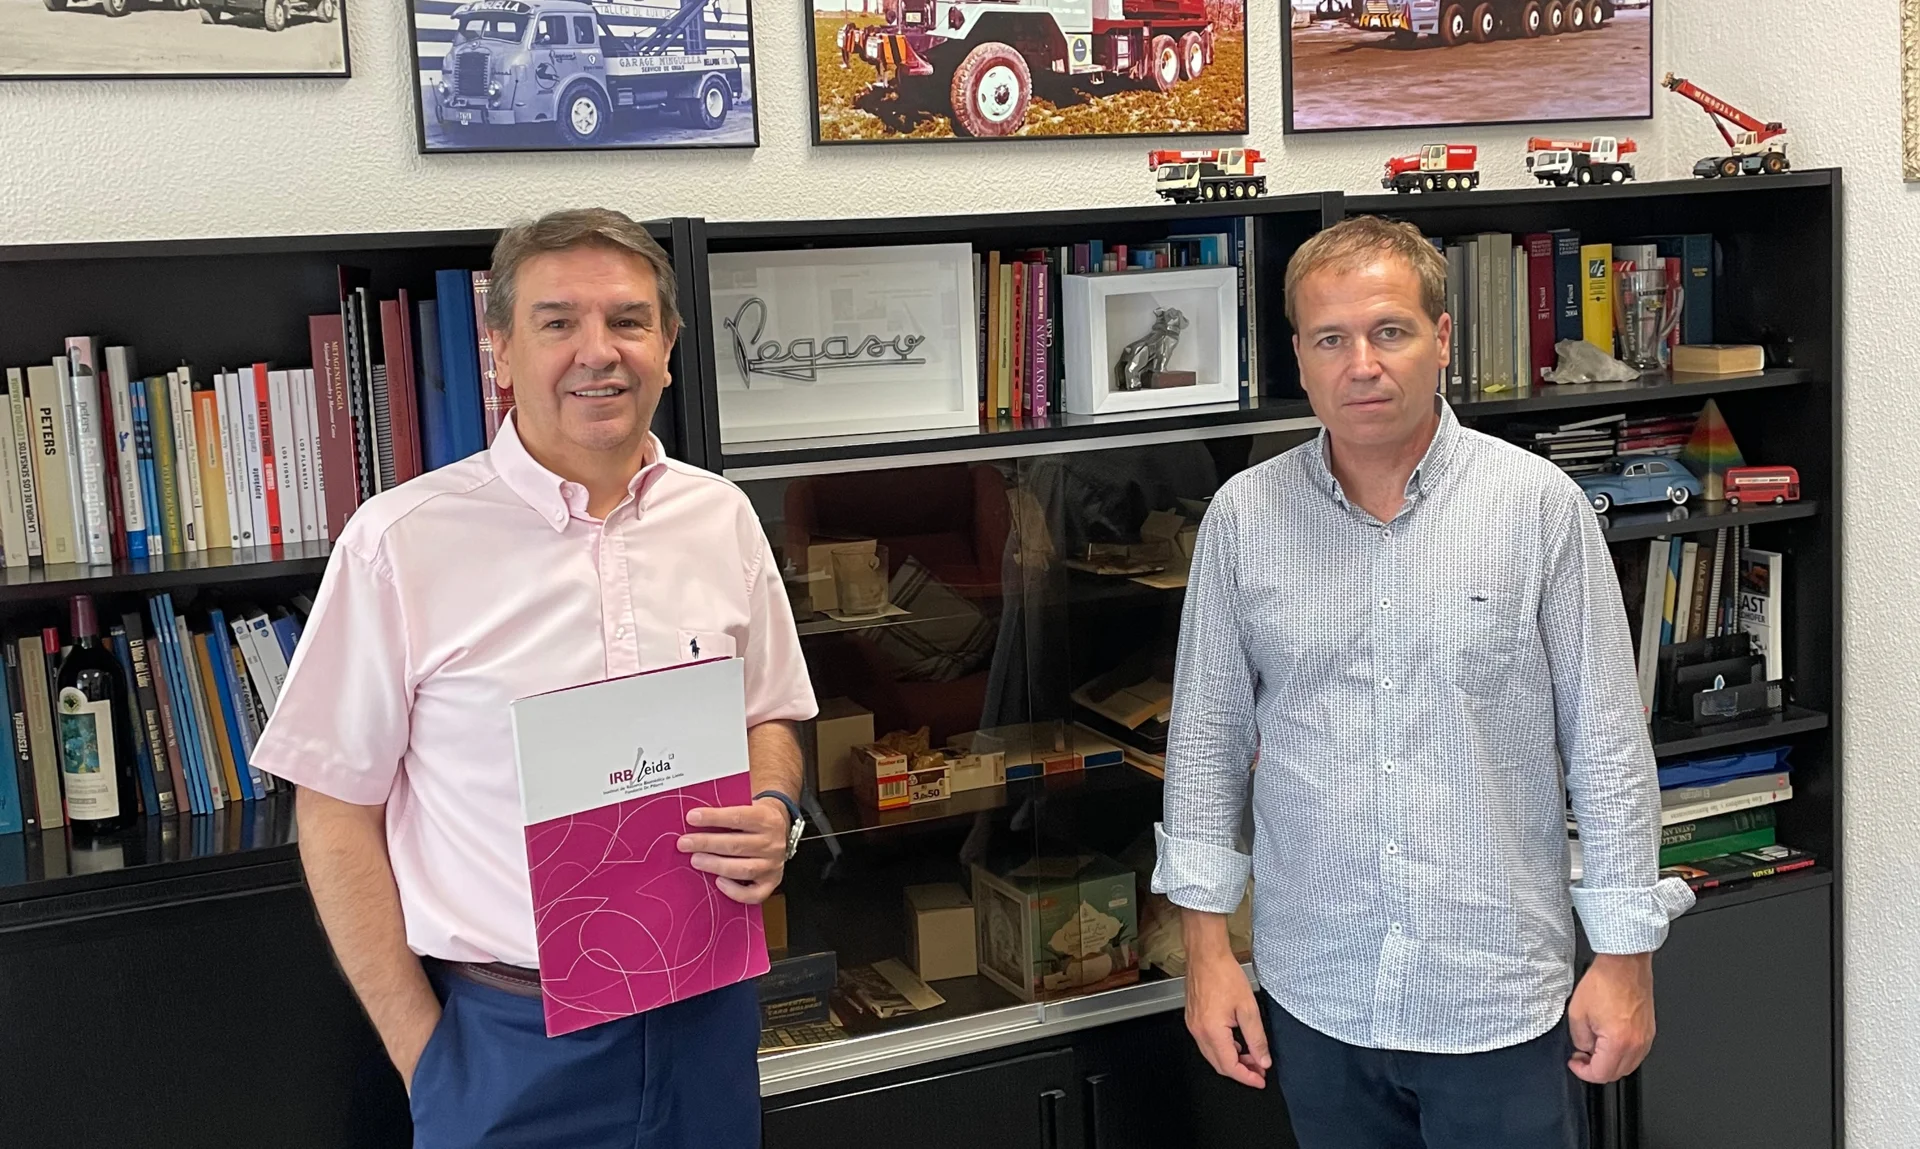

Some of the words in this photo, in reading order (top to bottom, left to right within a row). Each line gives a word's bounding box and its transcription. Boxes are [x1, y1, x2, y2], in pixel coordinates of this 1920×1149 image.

[619, 57, 654, 68] GARAGE
[659, 56, 702, 66] MINGUELLA
[1036, 323, 1045, 362] BUZAN
[1626, 311, 1635, 351] inglés
[723, 297, 926, 389] Pegaso
[329, 340, 345, 410] METAGENEALOGÍA
[1035, 367, 1044, 399] TONY
[13, 404, 25, 440] LEOPOLDO
[78, 400, 92, 433] peters
[40, 407, 56, 456] PETERS
[17, 441, 29, 478] SENSATOS
[281, 462, 290, 489] SIGNOS
[299, 454, 308, 490] PLANETAS
[22, 478, 31, 492] LOS
[24, 493, 32, 503] DE
[25, 503, 35, 523] HORA
[131, 516, 137, 524] La
[28, 523, 36, 532] LA
[1695, 559, 1707, 592] VIAJES
[1694, 595, 1702, 610] SIN
[1741, 596, 1765, 614] AST
[128, 638, 143, 647] El
[132, 660, 148, 672] del
[15, 712, 29, 761] e-TESORERÍA
[609, 769, 634, 785] IRB
[1662, 824, 1696, 836] CATALAN
[1752, 867, 1775, 878] PESADA
